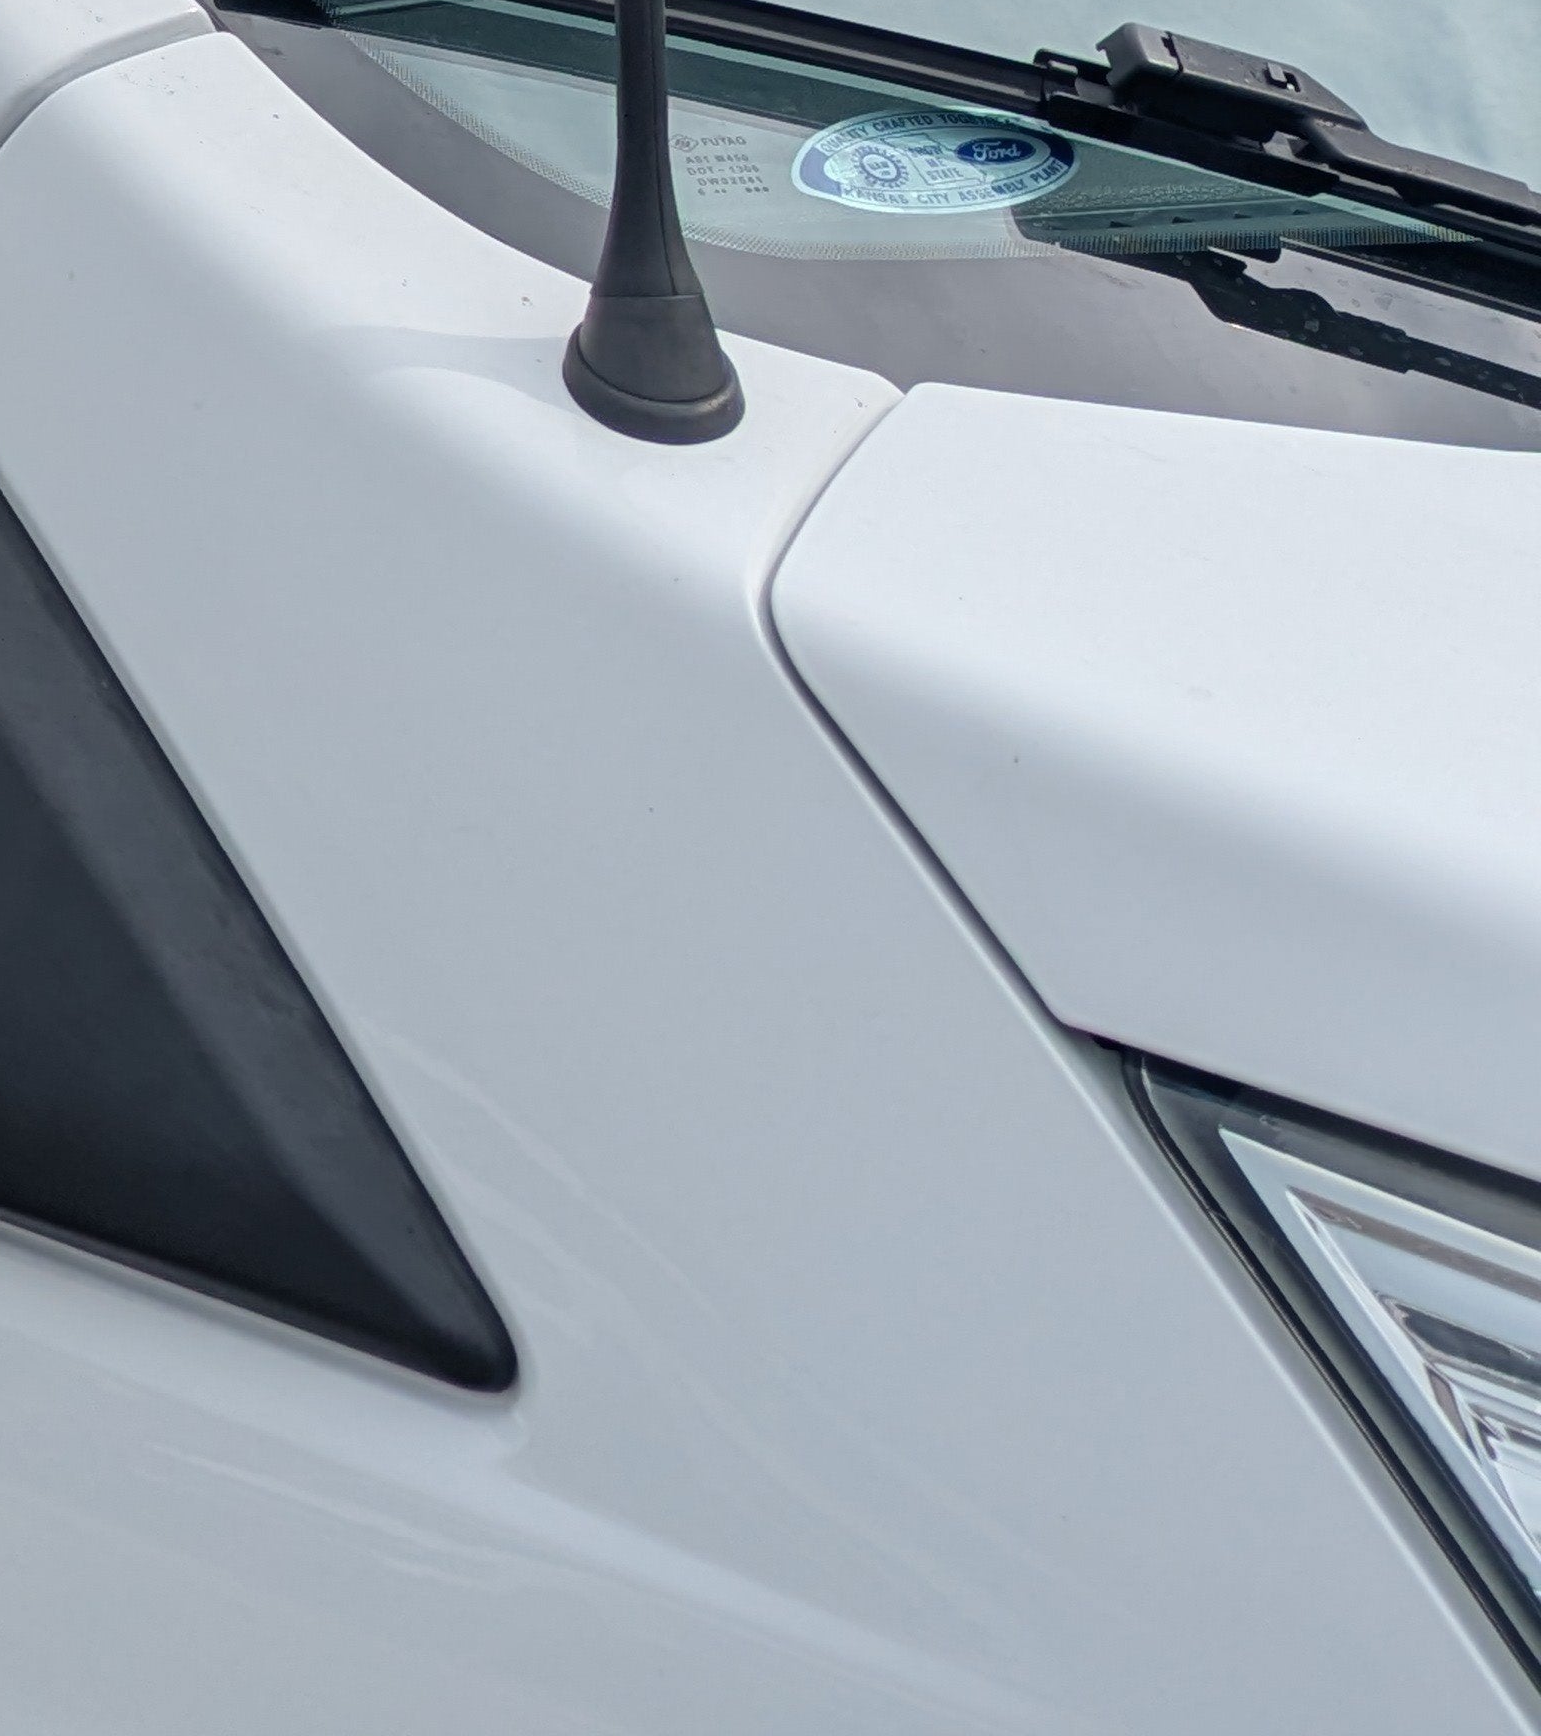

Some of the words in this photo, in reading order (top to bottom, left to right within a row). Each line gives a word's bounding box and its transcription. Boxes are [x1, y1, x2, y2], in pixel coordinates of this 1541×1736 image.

[972, 141, 1022, 162] Ford
[918, 192, 950, 204] CITY
[1029, 157, 1065, 184] PLANT
